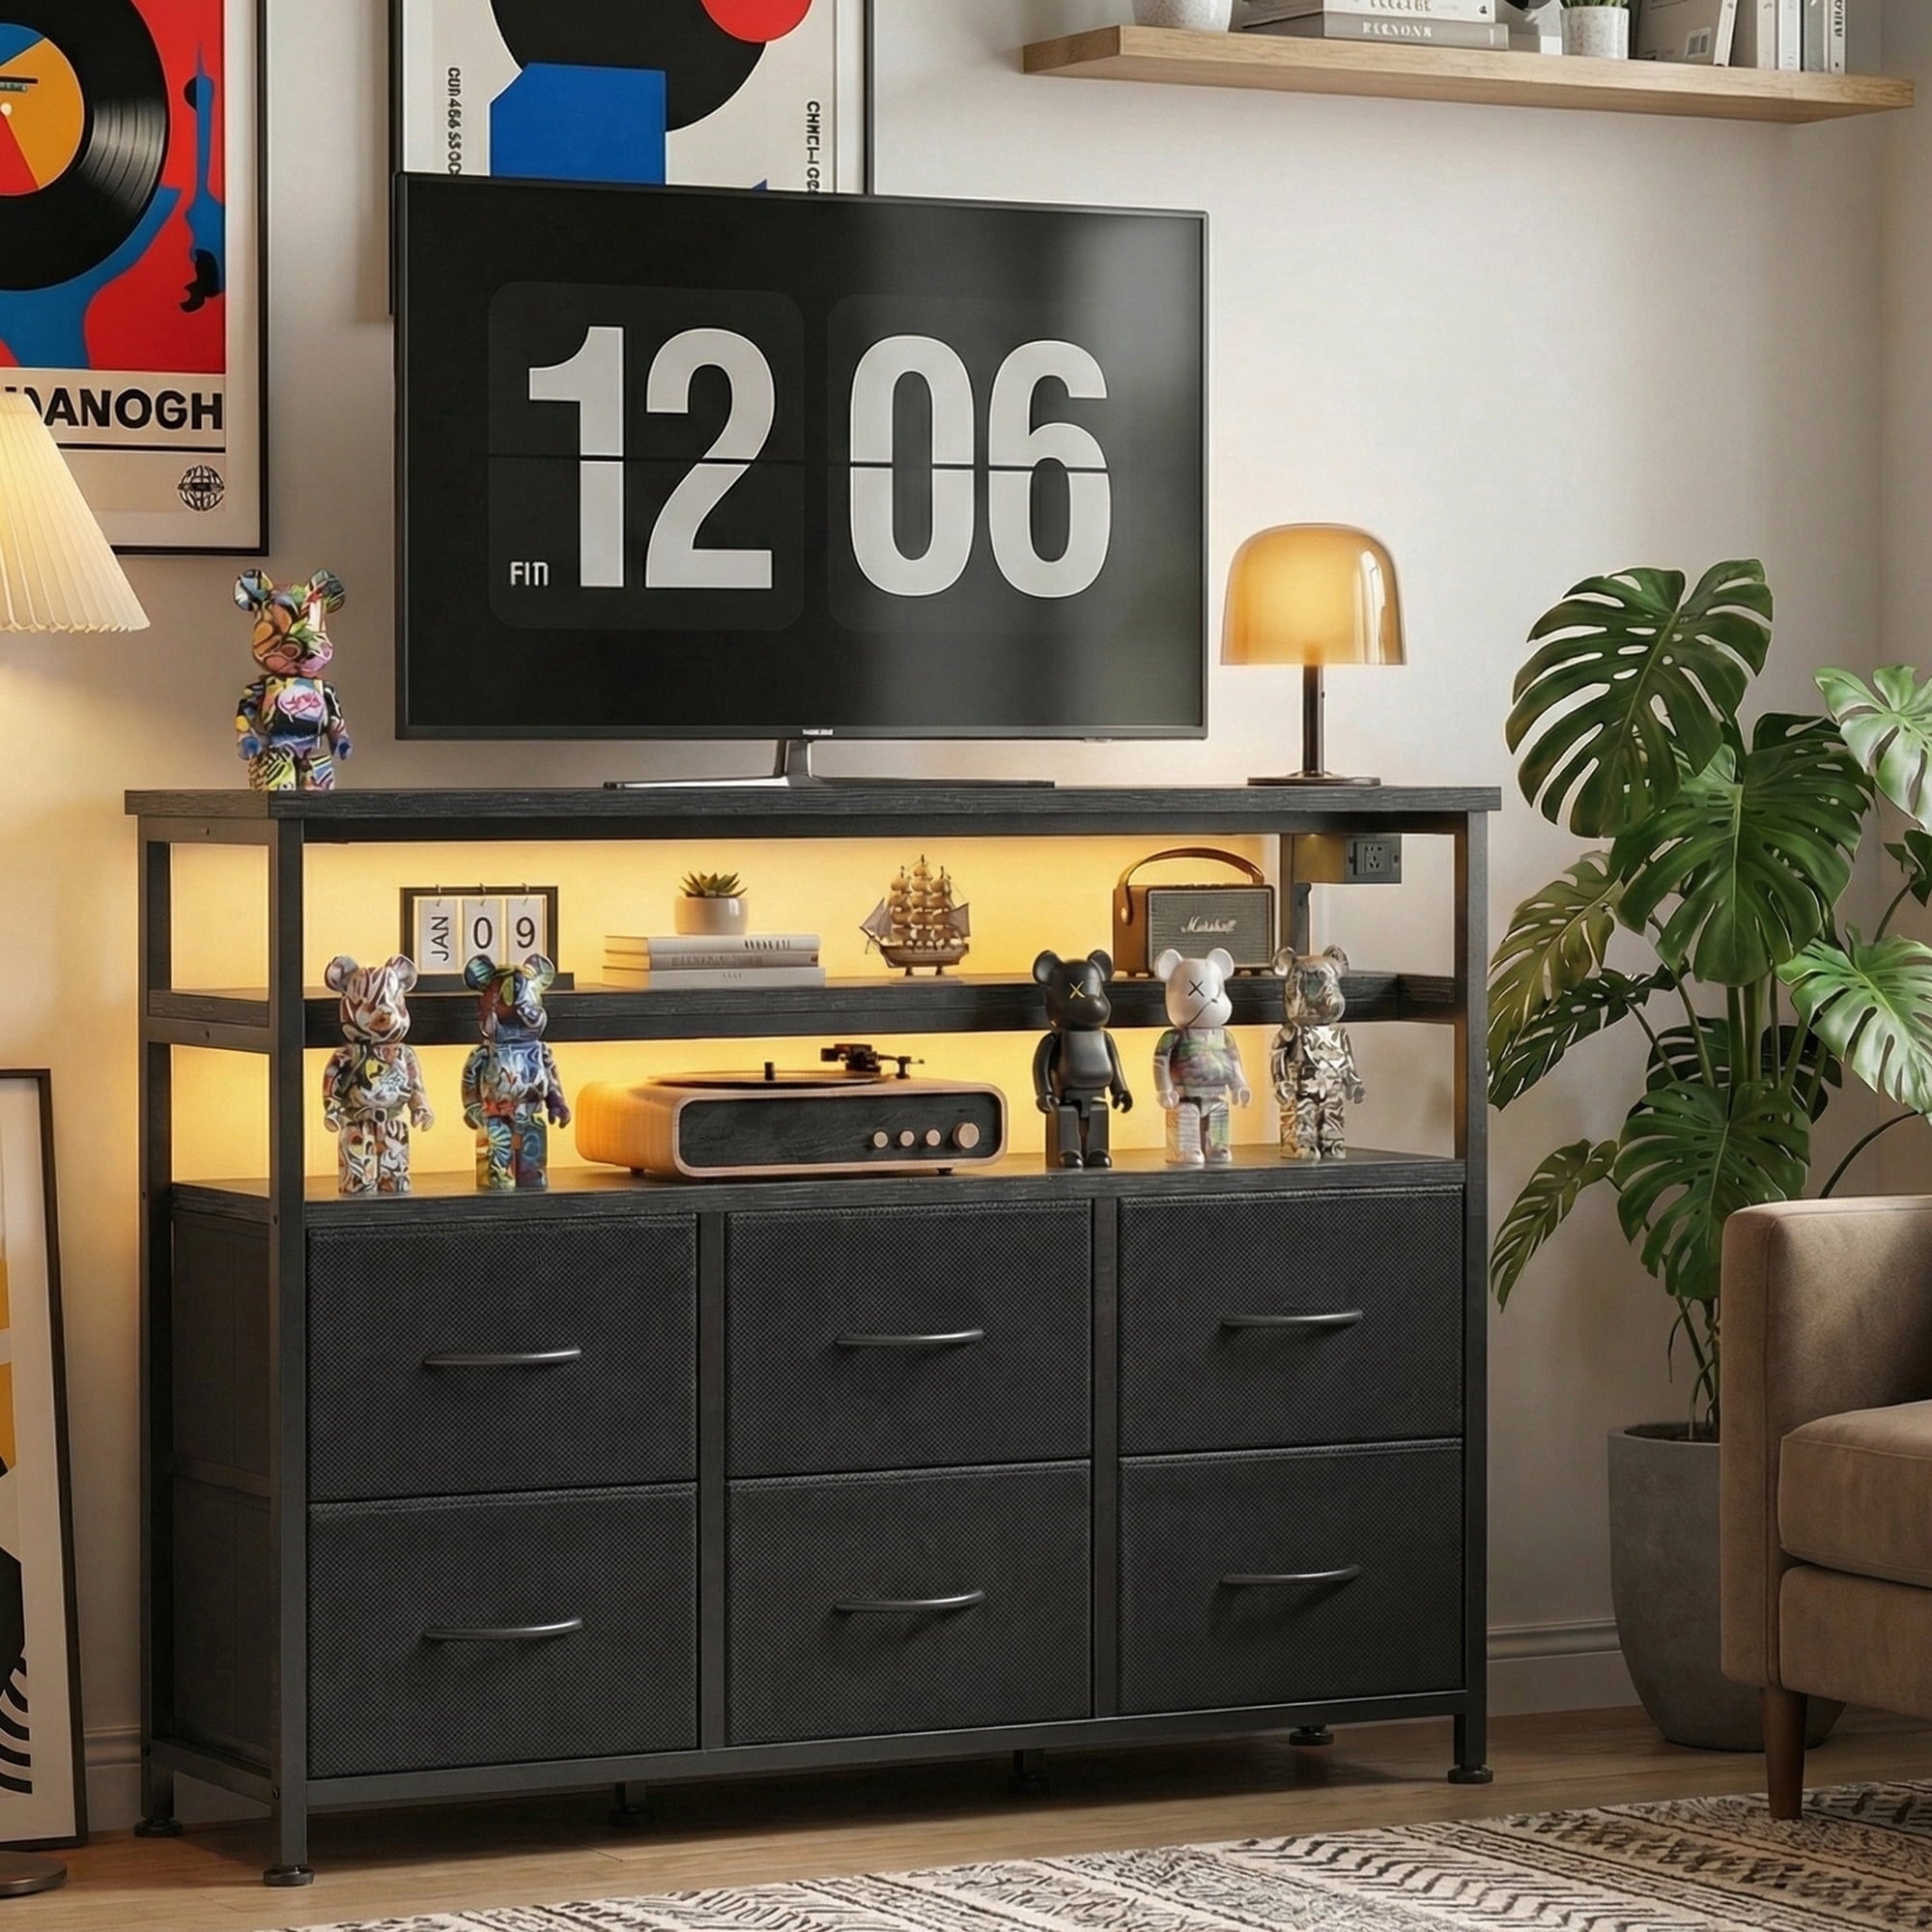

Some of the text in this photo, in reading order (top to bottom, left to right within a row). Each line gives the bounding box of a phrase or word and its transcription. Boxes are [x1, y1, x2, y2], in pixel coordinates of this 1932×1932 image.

[5, 386, 223, 430] ANOGH
[528, 326, 1111, 598] 12 06
[431, 916, 449, 962] JAN
